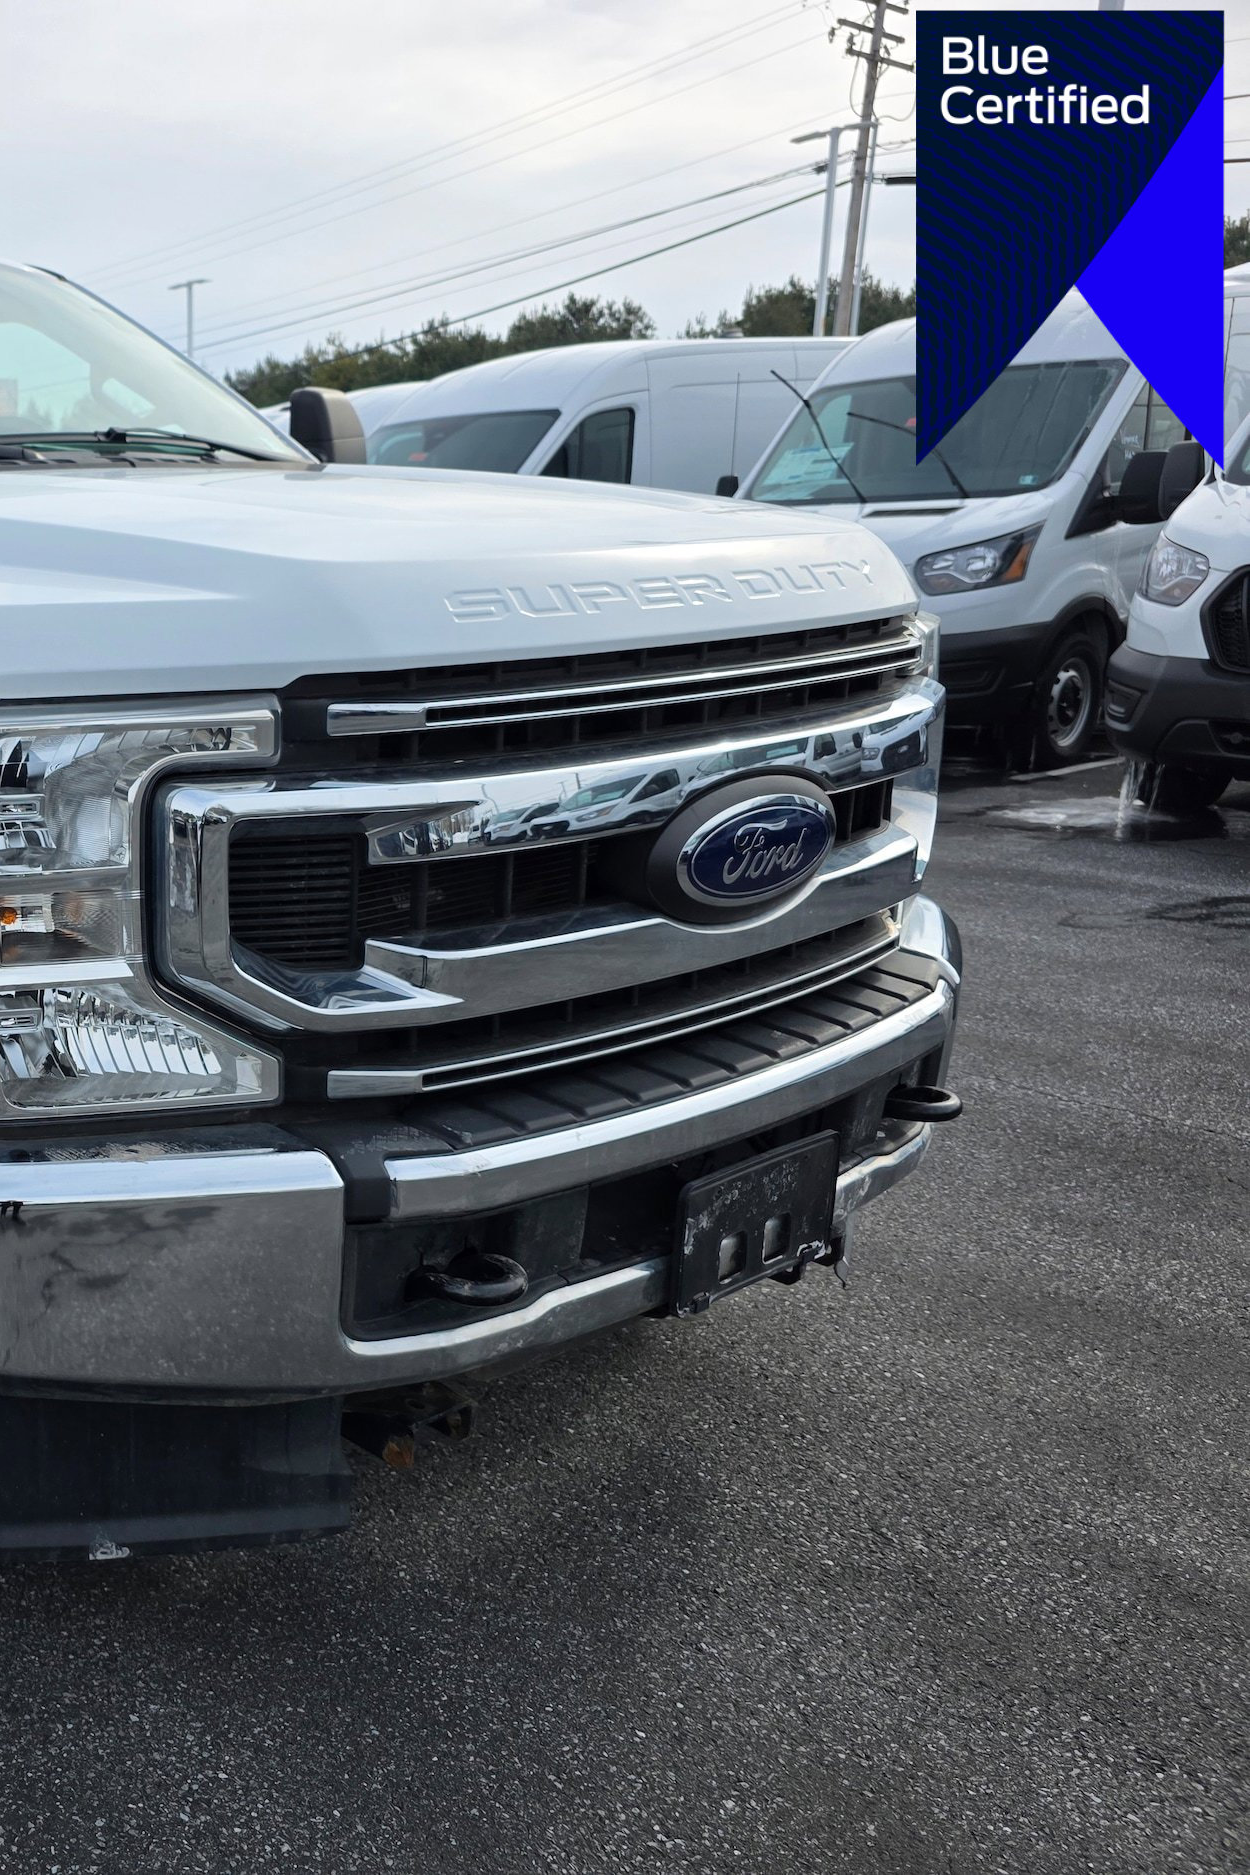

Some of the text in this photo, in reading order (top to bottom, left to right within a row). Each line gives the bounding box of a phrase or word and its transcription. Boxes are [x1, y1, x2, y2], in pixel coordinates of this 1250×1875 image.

[444, 559, 874, 623] SUPER DUTY
[723, 818, 808, 885] Ford
